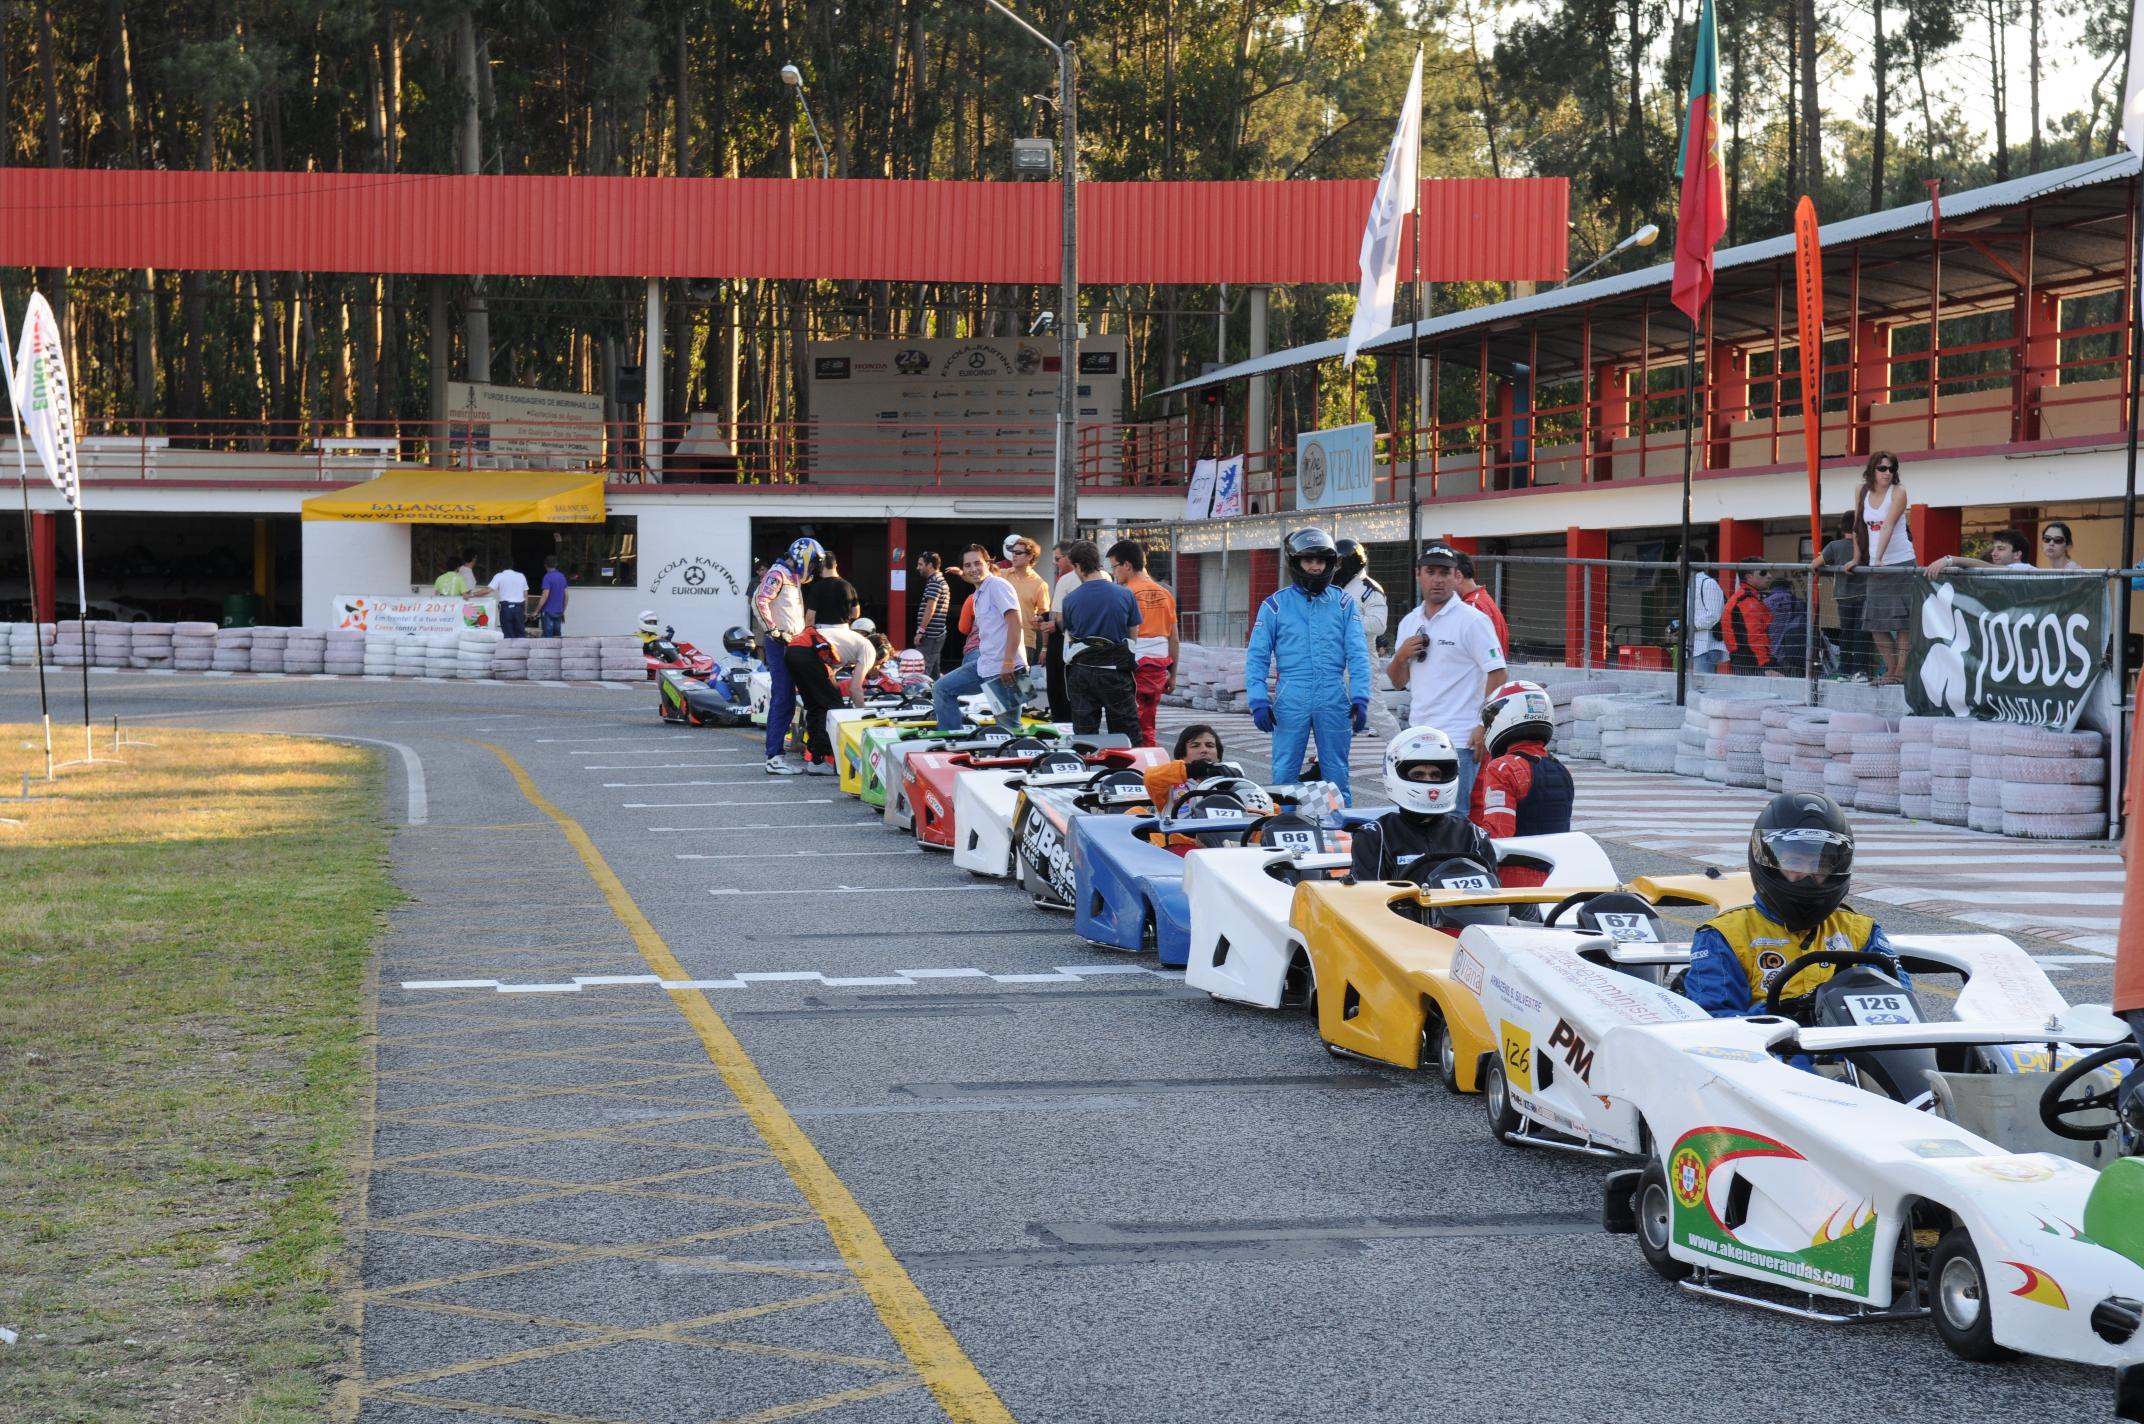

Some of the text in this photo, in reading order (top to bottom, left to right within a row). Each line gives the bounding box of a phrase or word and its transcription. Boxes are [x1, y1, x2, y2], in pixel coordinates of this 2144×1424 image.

[900, 352, 921, 365] 24
[940, 344, 1014, 377] ESCOLA KARTING
[959, 369, 997, 377] EUROINDY
[1329, 436, 1370, 492] VERÃO
[341, 511, 505, 522] www.pestronix.pt
[650, 556, 740, 596] ESCOLA KARTING
[671, 586, 720, 595] EUROINDY
[372, 603, 456, 613] 10 abril 2011
[394, 624, 417, 632] contra
[1973, 611, 2092, 705] JOGOS
[1056, 763, 1079, 772] 39
[1121, 785, 1142, 793] 128
[1214, 810, 1236, 818] 127
[1282, 833, 1309, 843] 88
[1037, 822, 1077, 891] Beta
[1451, 878, 1483, 889] 129
[1605, 914, 1641, 928] 67
[1461, 954, 1481, 990] Viana
[1490, 975, 1511, 993] ARMAZENS
[1515, 990, 1542, 1013] SILVESTRE
[1856, 996, 1899, 1011] 126
[1870, 1014, 1897, 1024] 24
[1505, 1037, 1530, 1074] 126
[1688, 1232, 1855, 1291] www.akenaverandas.com
